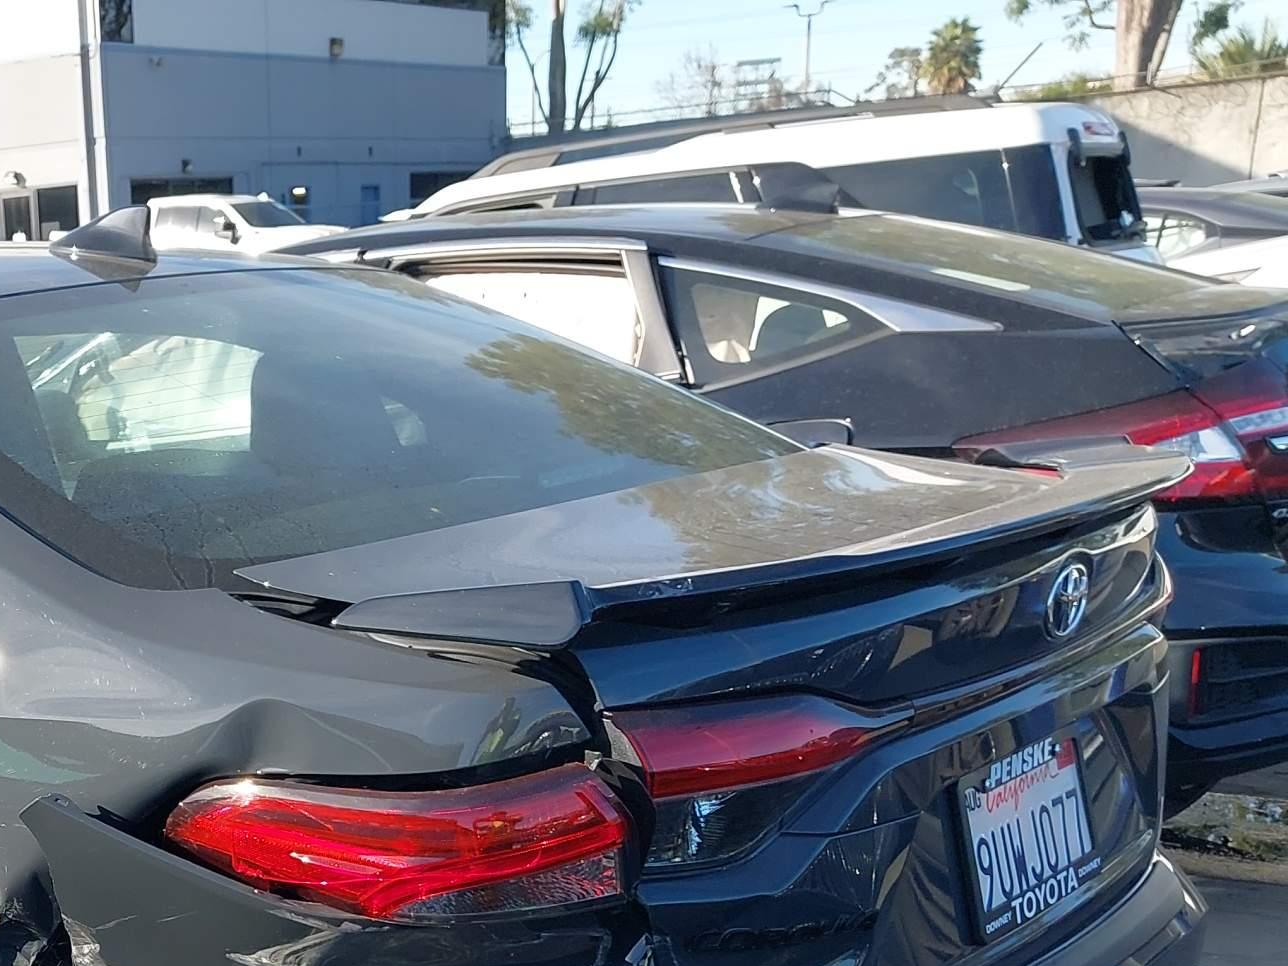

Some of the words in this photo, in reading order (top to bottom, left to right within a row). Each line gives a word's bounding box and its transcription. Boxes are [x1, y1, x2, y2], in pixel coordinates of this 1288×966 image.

[990, 738, 1054, 785] PENSKE
[985, 764, 1059, 814] California
[977, 788, 1092, 913] 9UWJ077
[1078, 857, 1102, 878] DOWNEY
[1011, 867, 1079, 925] TOYOTA
[985, 910, 1012, 935] DOWNEY
